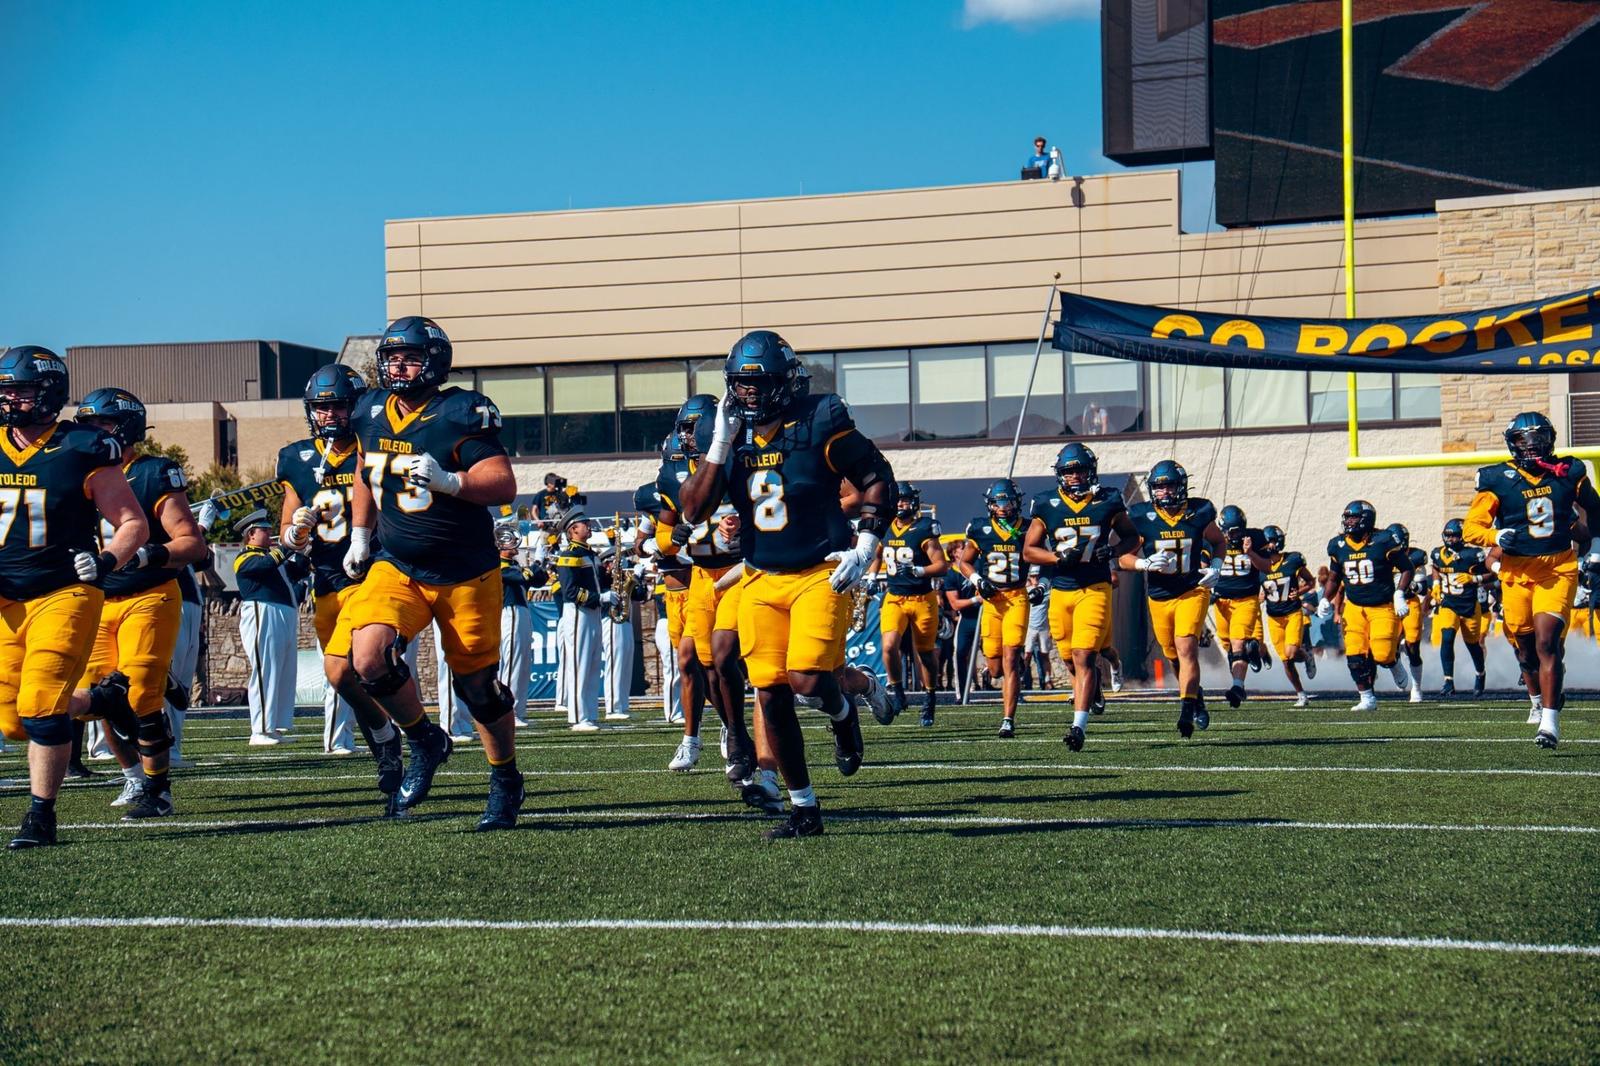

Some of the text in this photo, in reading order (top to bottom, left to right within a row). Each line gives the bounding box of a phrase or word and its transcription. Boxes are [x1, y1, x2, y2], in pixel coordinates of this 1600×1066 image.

[1297, 291, 1600, 356] ROCKE
[476, 405, 503, 429] 73
[102, 437, 121, 460] 71
[379, 438, 412, 453] TOLEDO
[218, 480, 286, 511] TOLEDO
[363, 452, 433, 513] 73
[1522, 486, 1553, 498] TOLEDO
[312, 486, 353, 543] 3
[746, 469, 789, 530] 8
[0, 488, 47, 548] 71
[1064, 517, 1090, 526] TOLEDO
[1526, 496, 1554, 538] 9
[993, 544, 1016, 552] TOLEDO
[1054, 526, 1101, 562] 27
[1160, 530, 1185, 539] TOLEDO
[986, 552, 1021, 583] 21
[1343, 559, 1375, 585] 50
